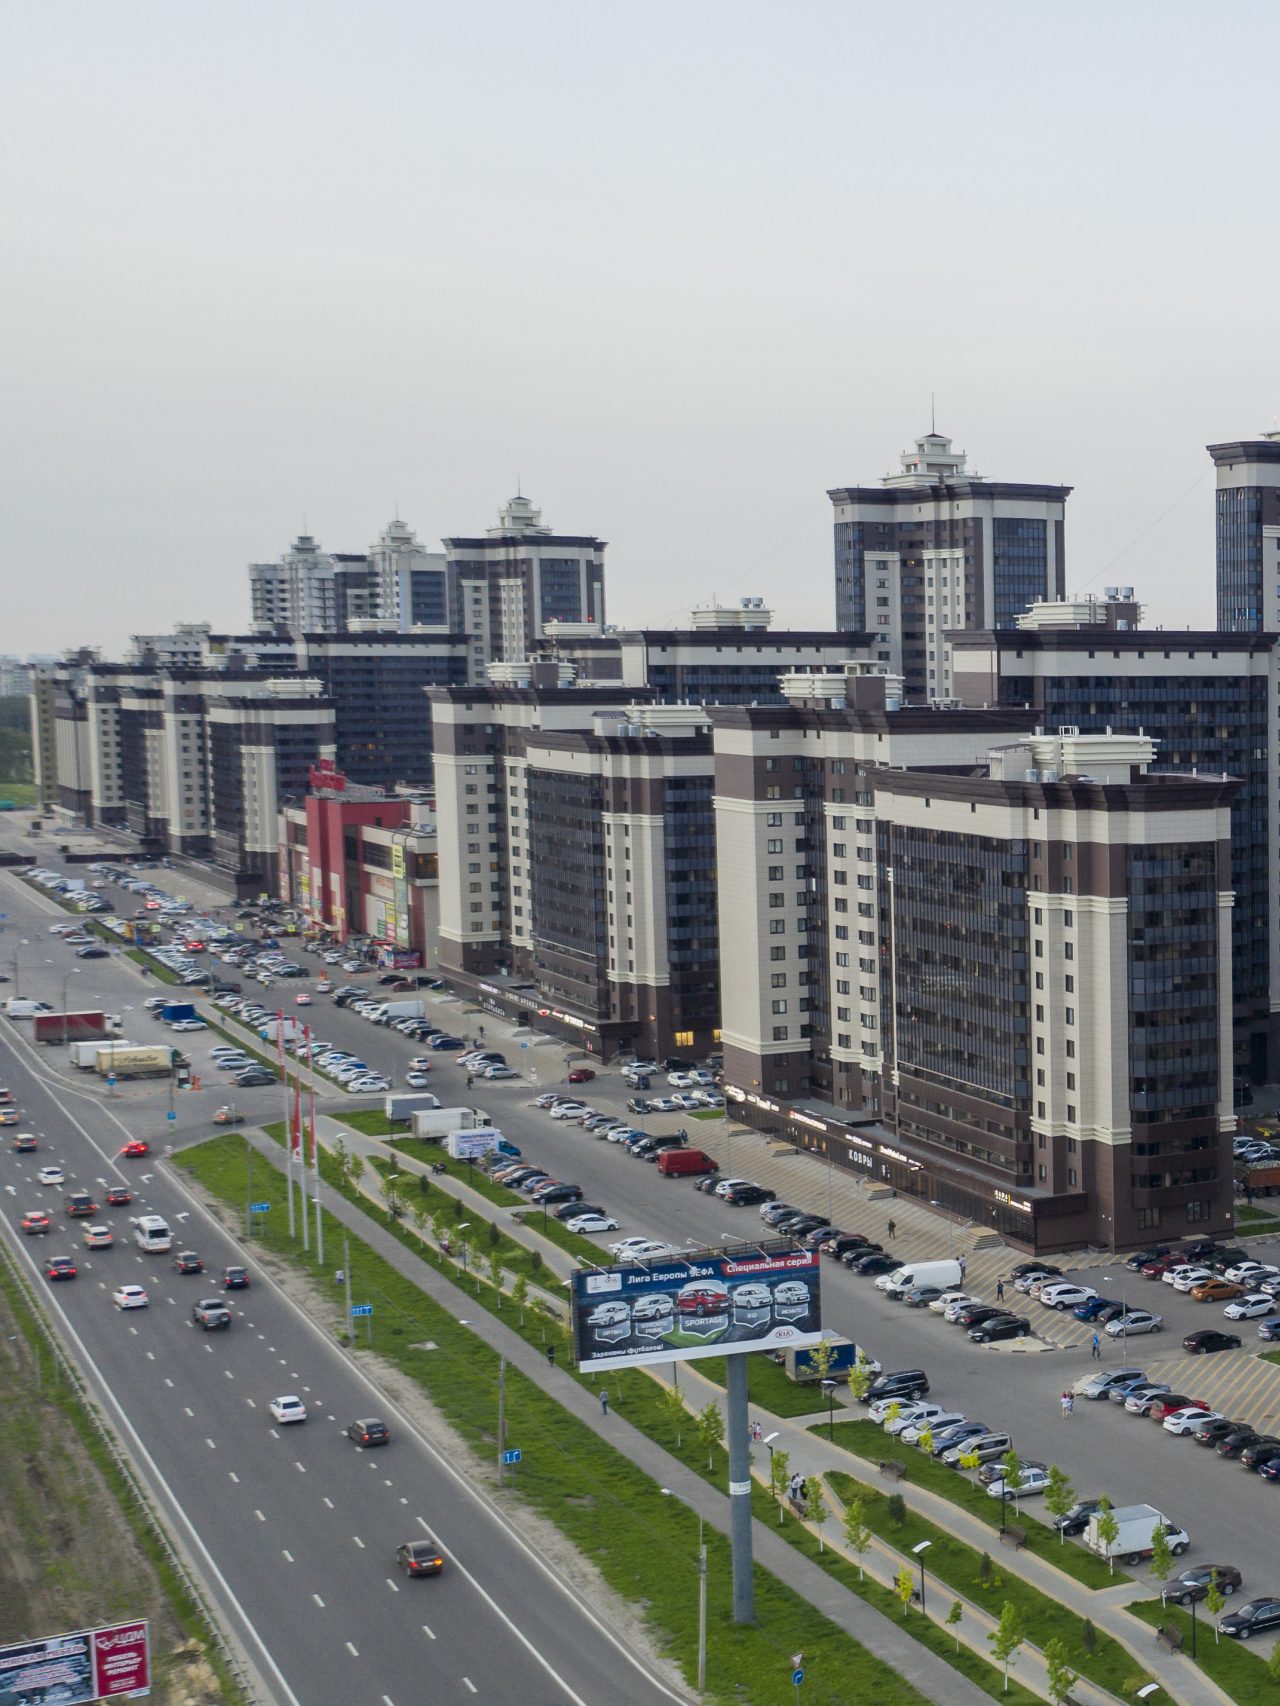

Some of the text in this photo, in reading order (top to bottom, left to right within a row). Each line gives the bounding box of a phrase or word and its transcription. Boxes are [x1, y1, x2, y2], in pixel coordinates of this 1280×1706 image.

[848, 1149, 873, 1169] КОВРЫ
[726, 1257, 812, 1275] Специальная серия
[627, 1275, 651, 1285] Лига
[652, 1271, 688, 1282] Европы
[684, 1315, 725, 1328] SPORTAGE
